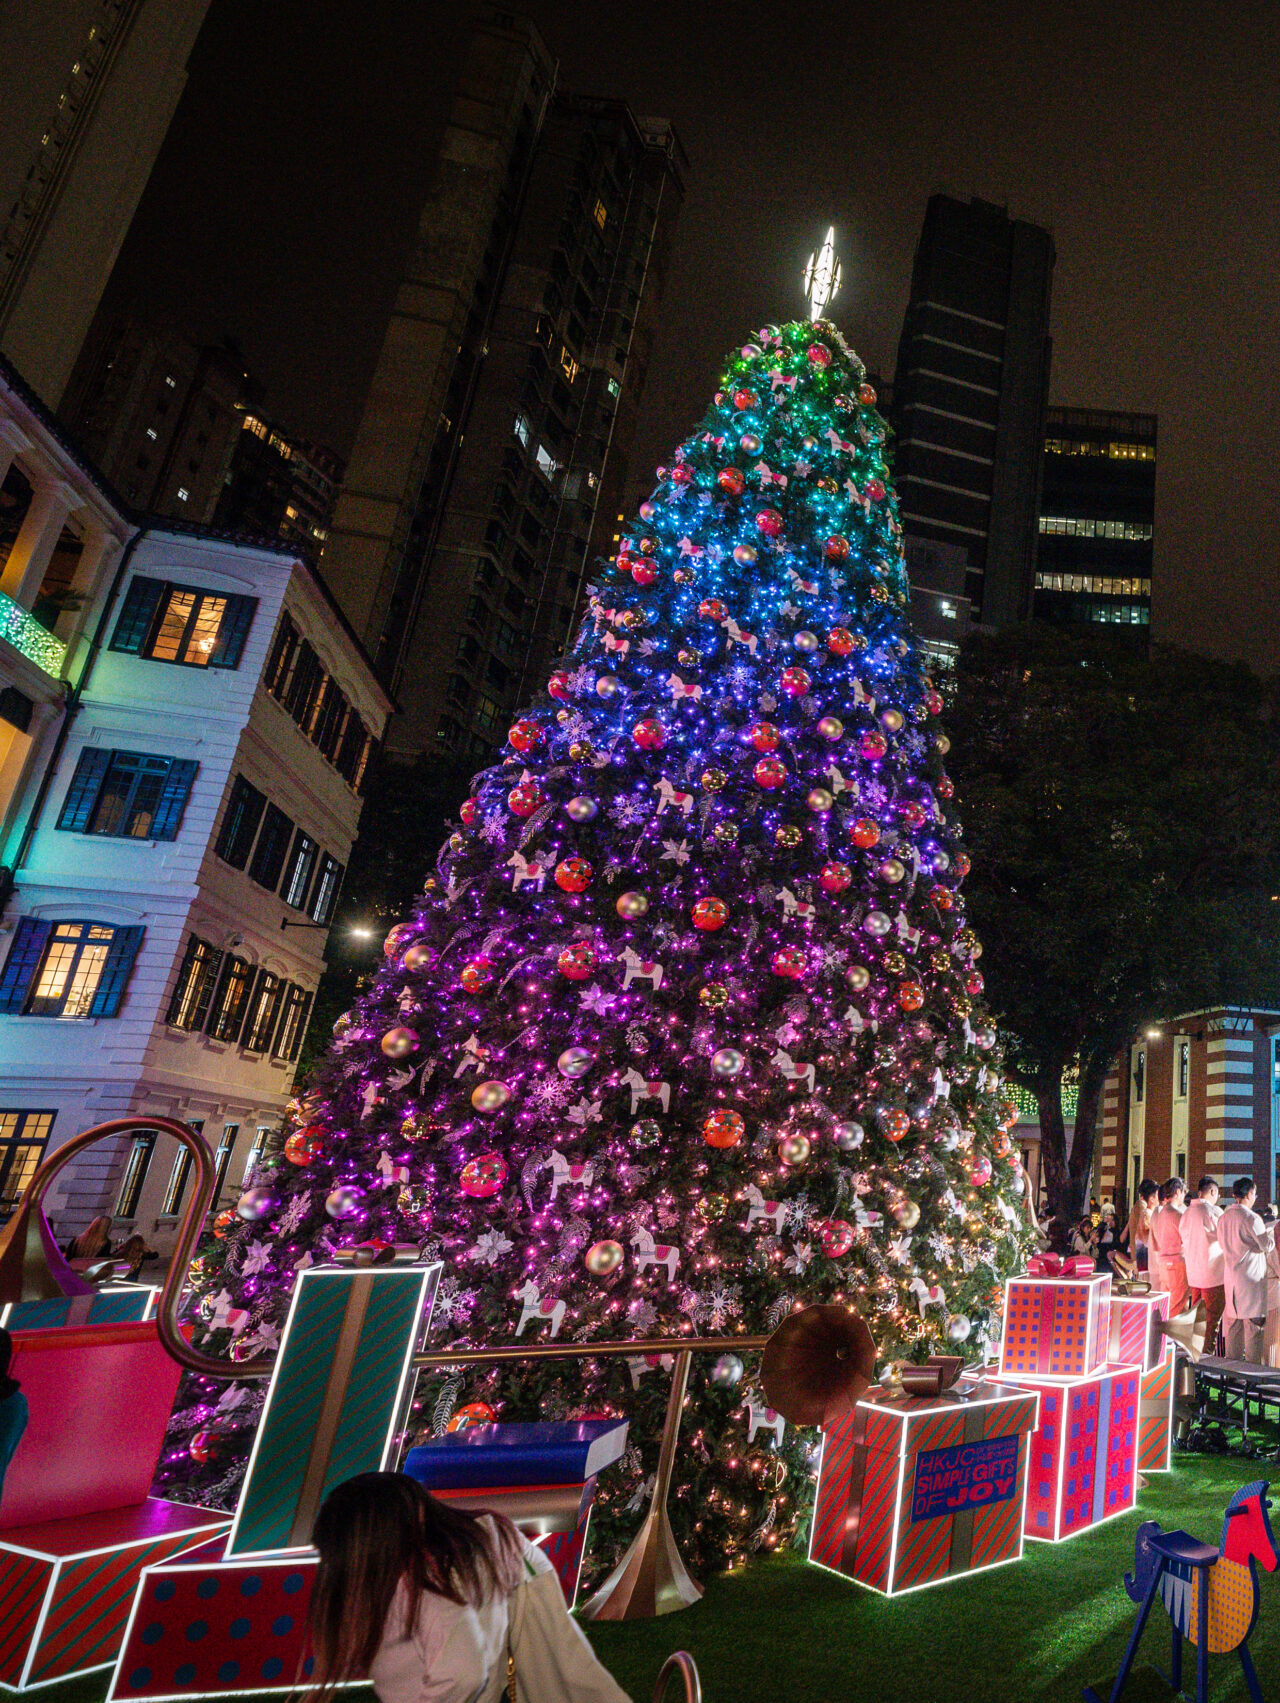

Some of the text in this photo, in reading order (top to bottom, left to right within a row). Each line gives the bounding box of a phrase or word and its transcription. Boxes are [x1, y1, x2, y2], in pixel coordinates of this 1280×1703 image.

[916, 1457, 1014, 1495] SIMPLE GIFTS
[919, 1448, 975, 1475] HKJC
[915, 1477, 1013, 1515] OF JOY
